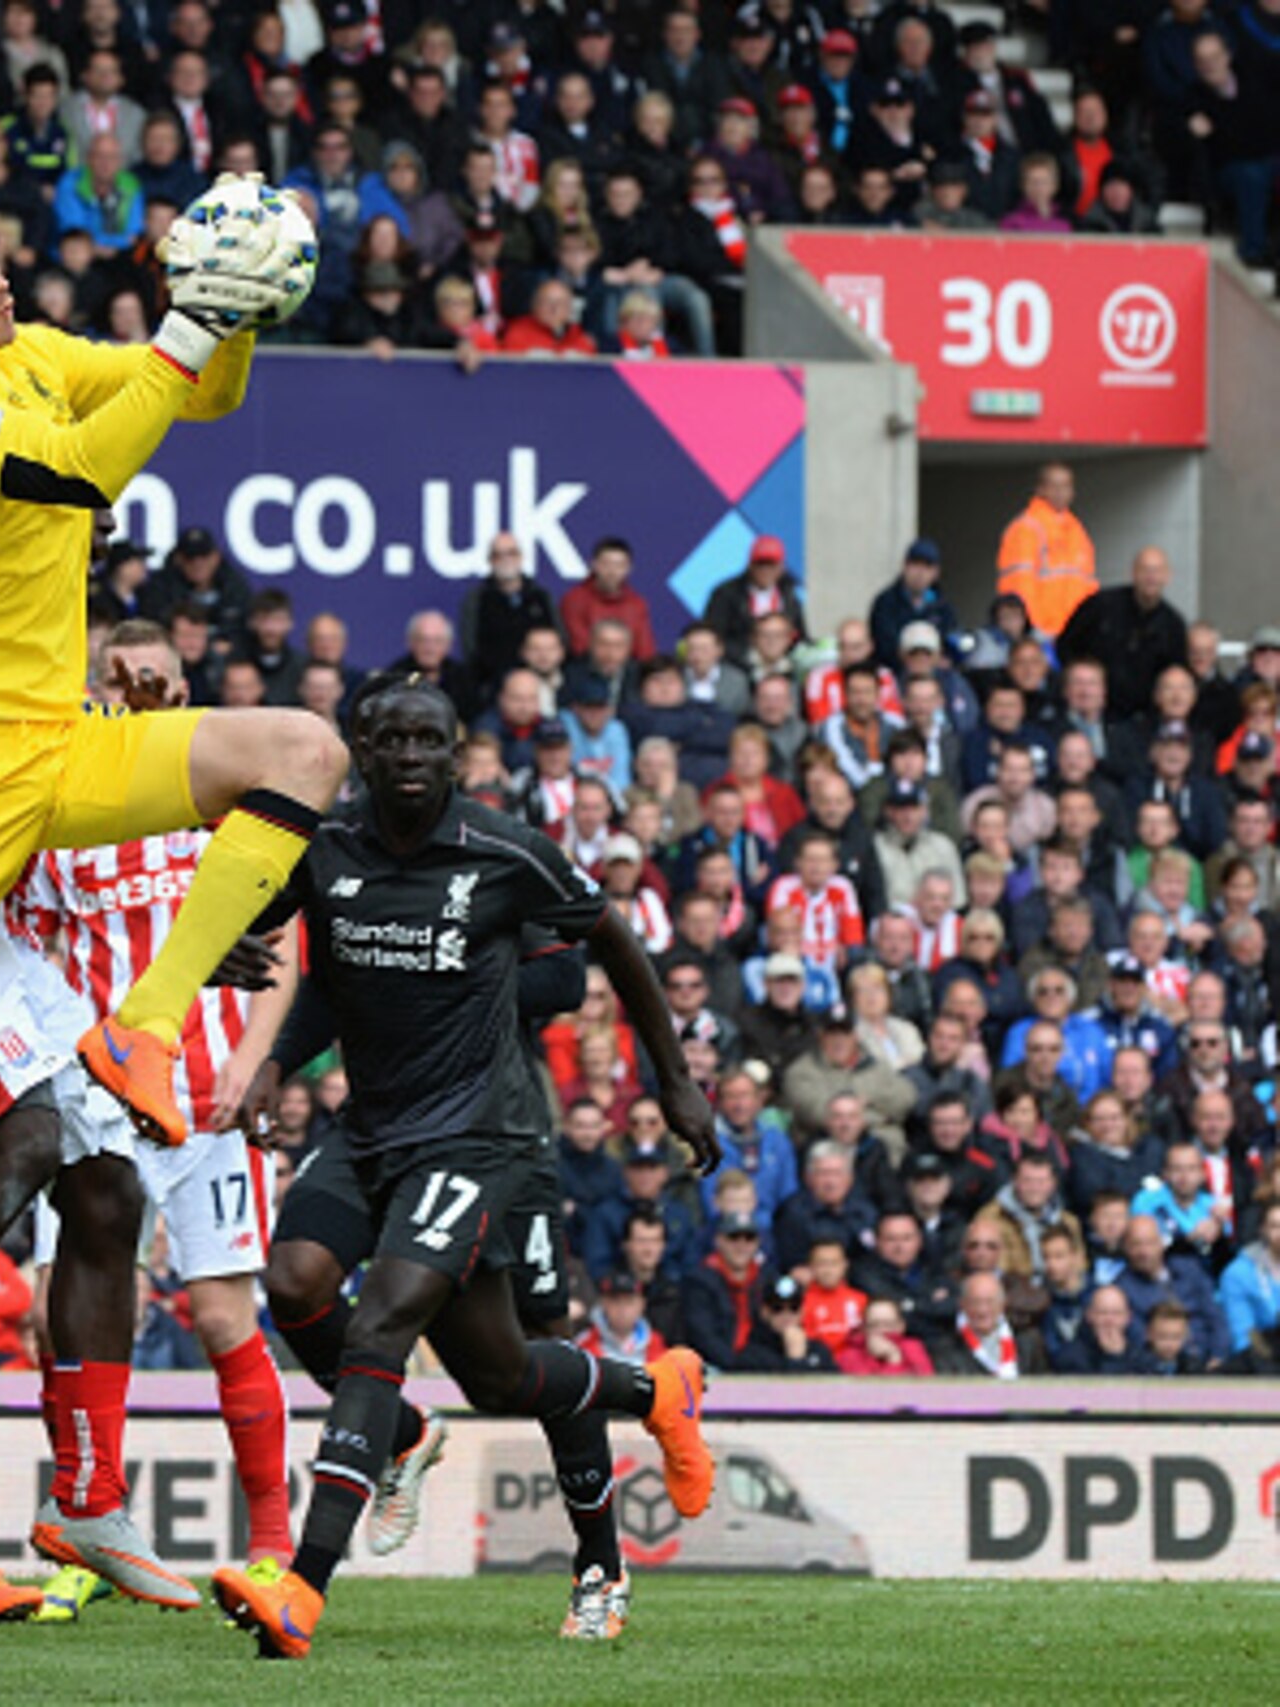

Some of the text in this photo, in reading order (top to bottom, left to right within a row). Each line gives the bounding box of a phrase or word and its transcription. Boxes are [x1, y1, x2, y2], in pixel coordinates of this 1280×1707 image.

[939, 278, 1052, 367] 30
[76, 869, 195, 914] bet365
[331, 917, 432, 945] Standard
[331, 940, 431, 971] Chartered
[210, 1173, 247, 1229] 17
[409, 1171, 481, 1232] 17
[525, 1214, 554, 1272] 4
[495, 1473, 557, 1511] DP
[968, 1455, 1236, 1562] DPD
